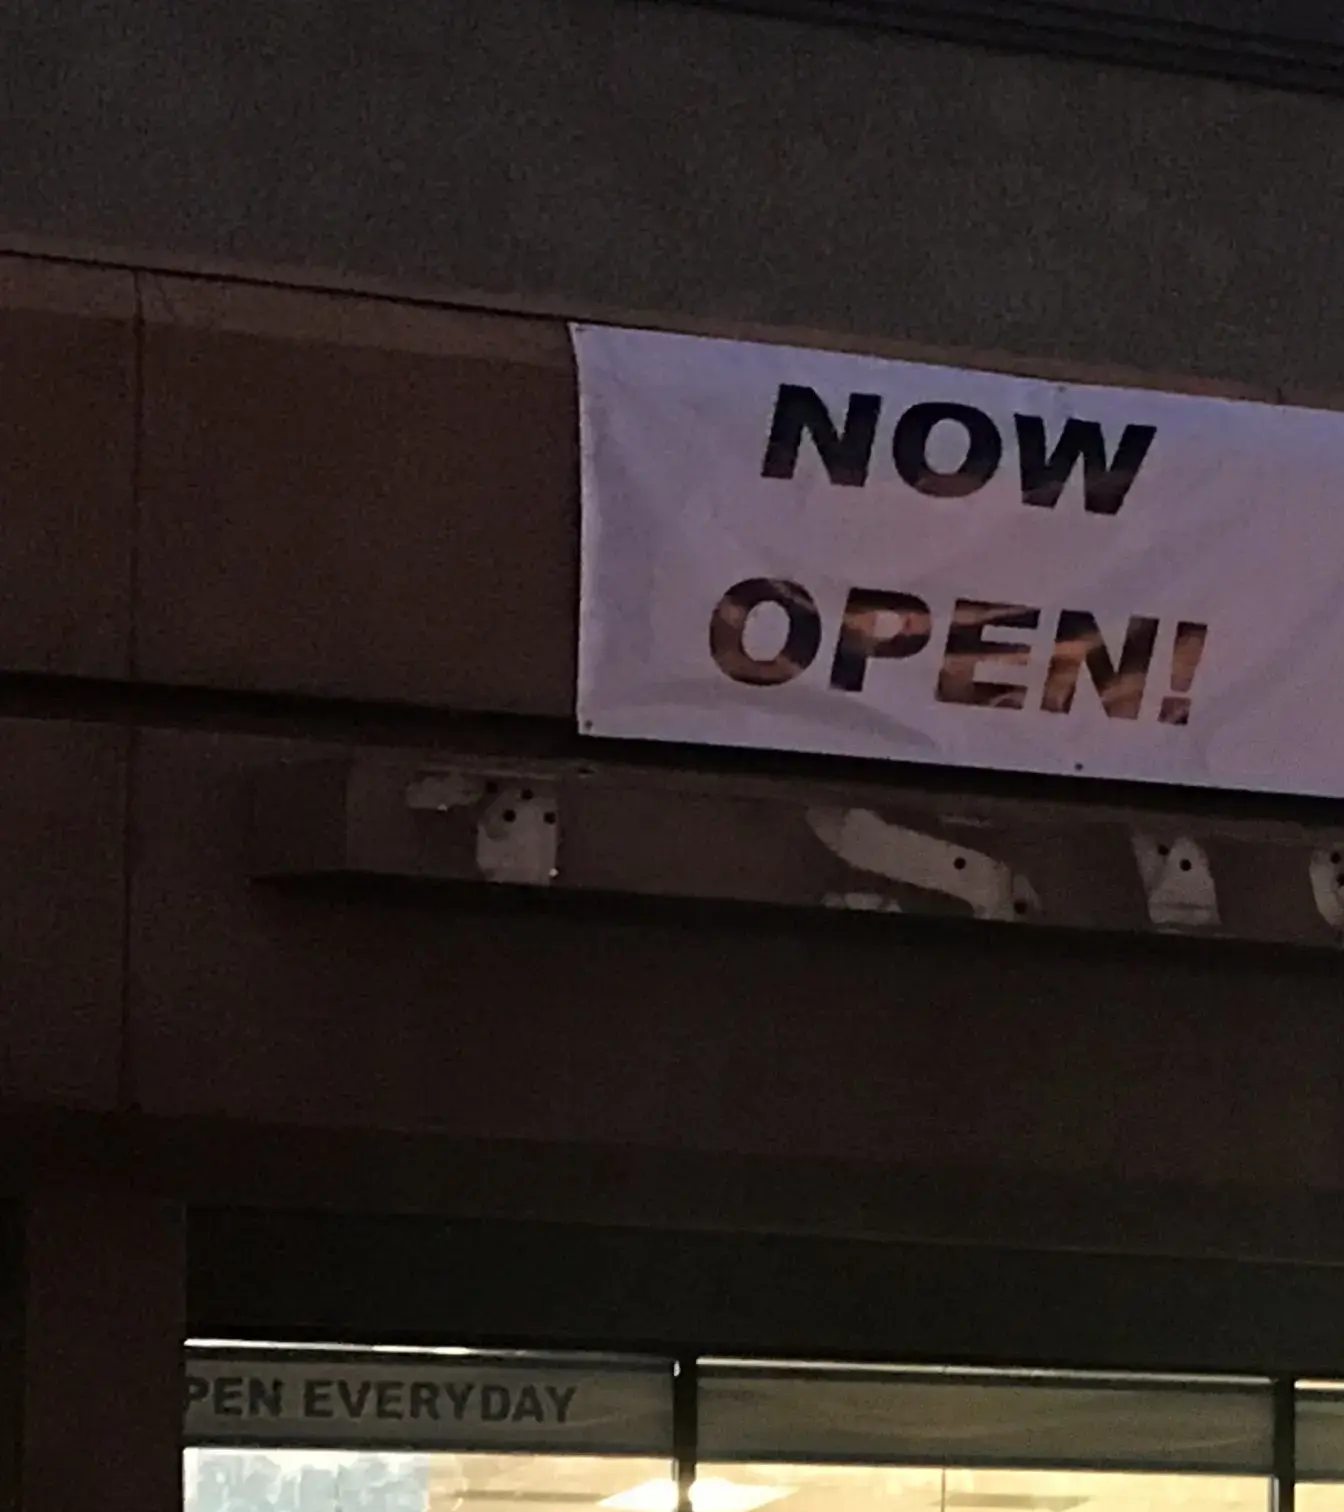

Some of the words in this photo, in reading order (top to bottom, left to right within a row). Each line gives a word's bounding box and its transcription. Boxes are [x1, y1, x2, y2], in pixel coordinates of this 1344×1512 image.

[760, 383, 1156, 515] NOW
[709, 577, 1208, 727] OPEN!
[303, 1378, 577, 1424] EVERYDAY
